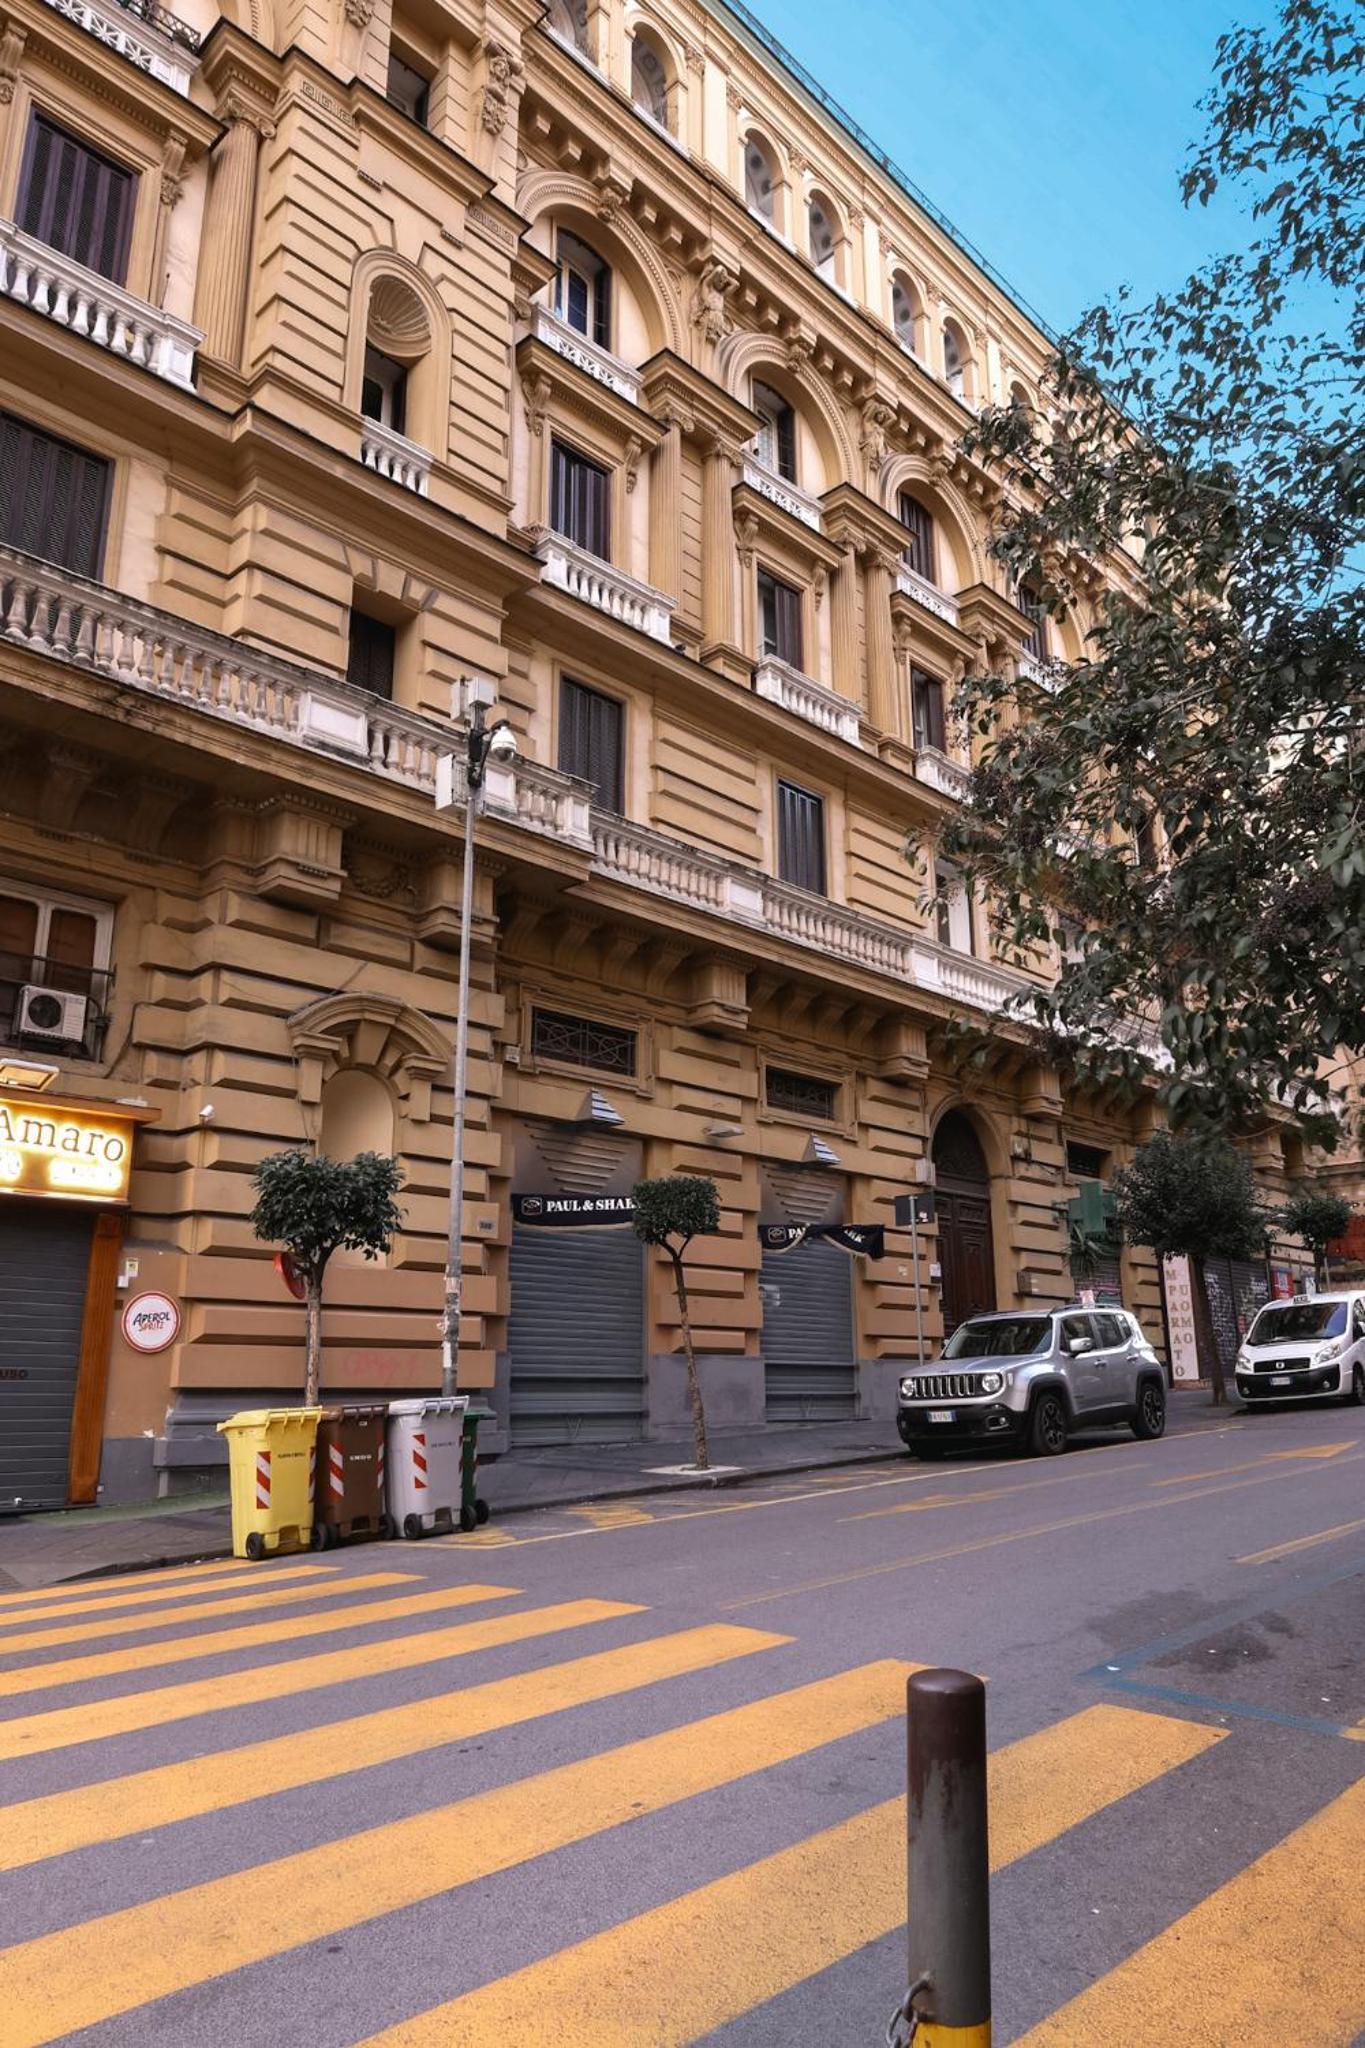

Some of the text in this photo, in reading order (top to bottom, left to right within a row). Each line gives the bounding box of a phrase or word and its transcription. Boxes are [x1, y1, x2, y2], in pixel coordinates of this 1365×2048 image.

[0, 1109, 124, 1161] Amaro
[546, 1198, 641, 1212] PAUL & SHAR
[133, 1311, 170, 1326] APEROL
[1166, 1269, 1186, 1377] MPARATO
[1179, 1284, 1193, 1344] UOMO
